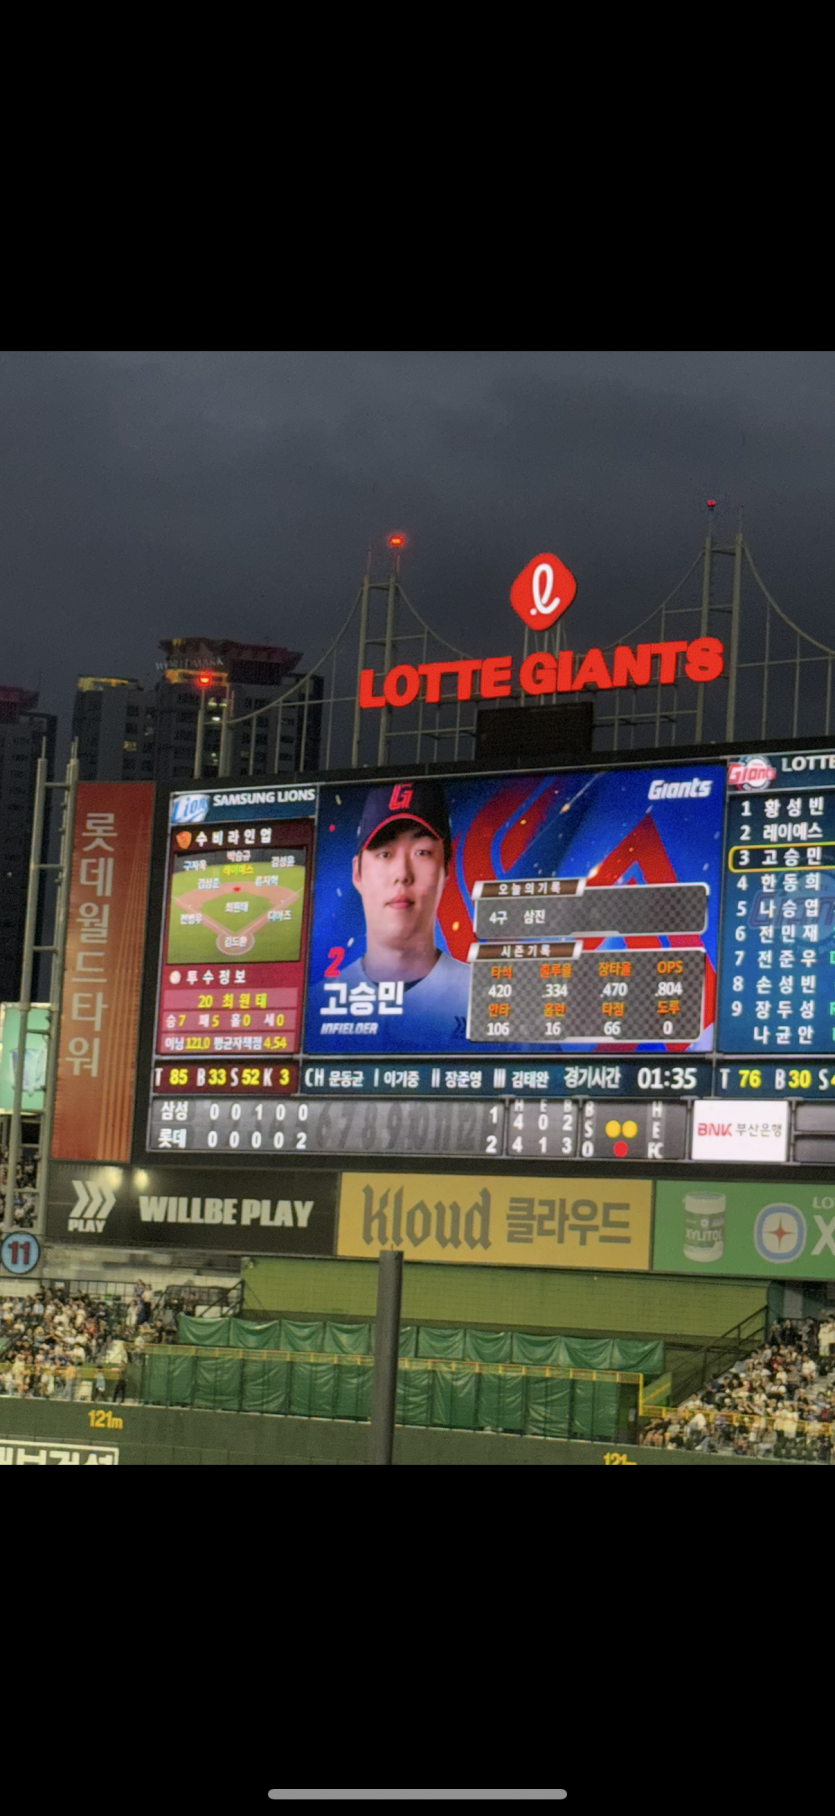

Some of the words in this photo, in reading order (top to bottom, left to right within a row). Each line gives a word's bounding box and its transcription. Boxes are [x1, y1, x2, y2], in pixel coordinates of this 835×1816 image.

[359, 656, 513, 708] LOTTE
[519, 637, 724, 695] GIANTS
[213, 792, 275, 807] SAMSUNG
[277, 789, 316, 803] LIONS
[648, 778, 713, 800] Giants
[741, 800, 752, 816] 1
[740, 825, 751, 840] 2
[739, 850, 750, 865] 3
[737, 875, 748, 890] 4
[489, 912, 508, 924] 4구
[523, 909, 546, 924] 삼진
[736, 901, 747, 917] 5
[735, 926, 746, 941] 6
[66, 812, 118, 1077] 롯데월드타워
[324, 947, 345, 978] 2
[735, 951, 745, 966] 7
[490, 966, 513, 979] 타석
[656, 961, 684, 974] OPS
[487, 984, 512, 998] 420
[541, 983, 568, 998] .334
[600, 982, 628, 998] .470
[654, 981, 683, 997] .804
[732, 976, 744, 992] 8
[198, 995, 213, 1008] 20
[320, 981, 404, 1016] 고승민
[488, 1003, 510, 1018] 안타
[602, 1002, 625, 1017] 타점
[656, 1000, 681, 1015] 도루
[731, 1001, 742, 1016] 9
[486, 1022, 510, 1036] 106
[544, 1022, 561, 1035] 16
[603, 1021, 621, 1035] 66
[663, 1020, 673, 1035] 0
[154, 1068, 164, 1086] T
[169, 1068, 188, 1086] 85
[196, 1068, 206, 1087] B
[207, 1068, 227, 1086] 33
[230, 1068, 240, 1087] S
[241, 1068, 261, 1086] 52
[262, 1067, 274, 1087] K
[278, 1068, 291, 1086] 3
[383, 1070, 420, 1088] 이기중
[444, 1070, 483, 1088] 장준영
[511, 1070, 549, 1088] 김태완
[563, 1066, 621, 1088] 경기시간
[637, 1067, 698, 1089] 01:35
[719, 1068, 730, 1090] T
[738, 1069, 762, 1088] 76
[774, 1068, 786, 1090] B
[787, 1069, 812, 1089] 30
[818, 1068, 829, 1091] S
[161, 1101, 188, 1121] 삼성
[209, 1103, 219, 1121] 0
[231, 1103, 241, 1121] 0
[254, 1103, 263, 1120] 1
[276, 1103, 286, 1121] 0
[298, 1104, 308, 1121] 0
[489, 1106, 498, 1124] 1
[513, 1114, 524, 1130] 4
[538, 1114, 549, 1131] 0
[562, 1114, 573, 1131] 2
[697, 1122, 733, 1137] BNK
[735, 1123, 783, 1138] 부산은행
[158, 1128, 187, 1148] 롯데
[207, 1131, 218, 1148] 0
[229, 1131, 240, 1148] 0
[251, 1131, 262, 1149] 0
[273, 1131, 284, 1149] 0
[296, 1132, 307, 1149] 2
[485, 1135, 497, 1153] 2
[512, 1136, 523, 1153] 4
[538, 1136, 548, 1153] 1
[561, 1137, 573, 1154] 3
[241, 1199, 314, 1228] PLAY
[506, 1197, 632, 1246] 클라우드
[68, 1219, 106, 1233] PLAY
[8, 1241, 31, 1265] 11
[88, 1409, 123, 1430] 121m
